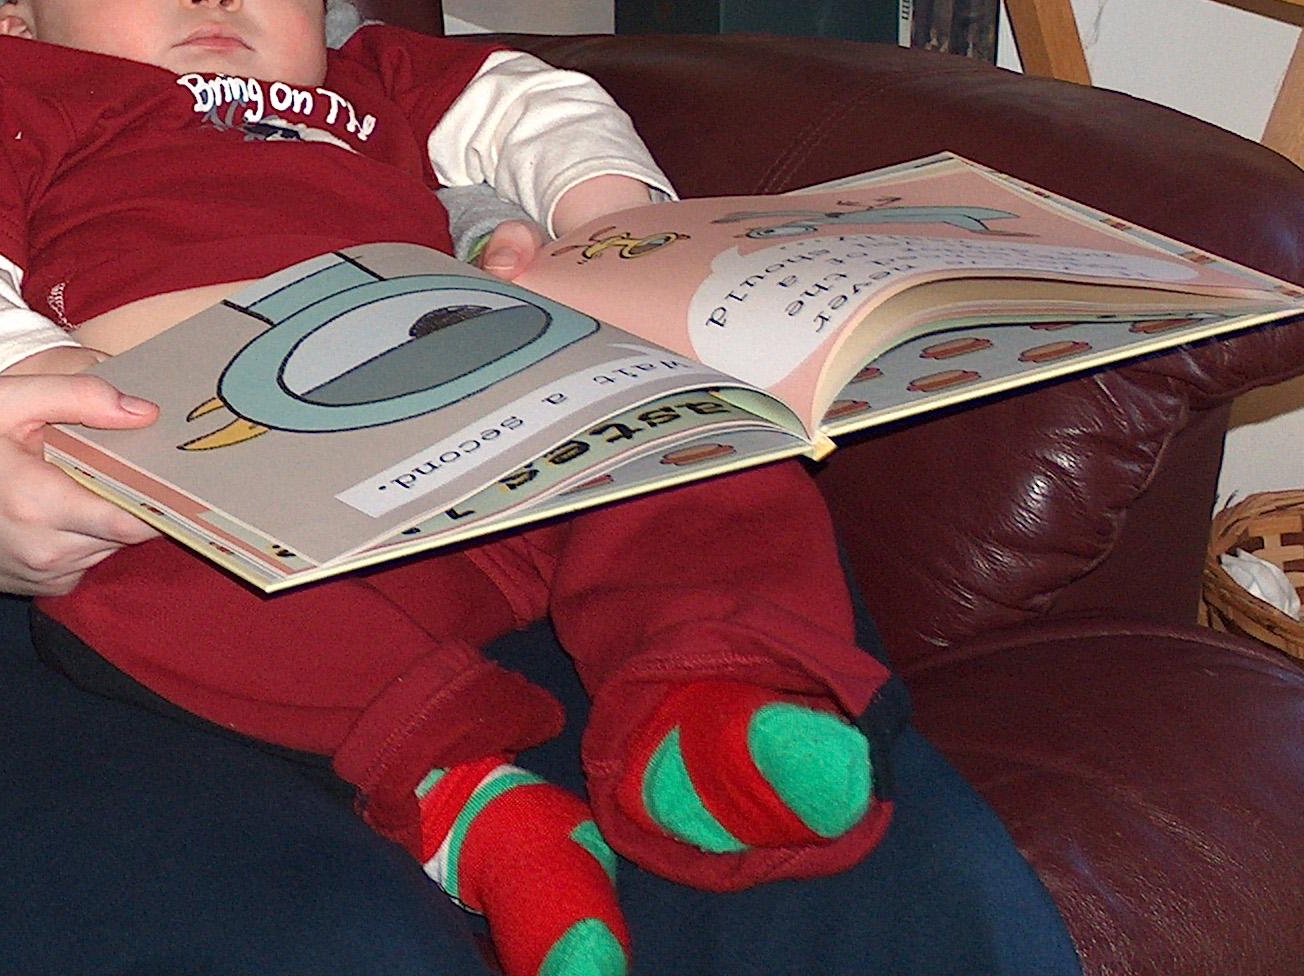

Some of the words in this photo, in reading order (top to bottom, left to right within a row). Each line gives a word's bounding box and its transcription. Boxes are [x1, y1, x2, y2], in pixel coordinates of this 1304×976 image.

[177, 73, 265, 123] Bring
[705, 248, 832, 329] should
[777, 274, 798, 289] a
[785, 271, 848, 317] the
[593, 357, 695, 387] Wait
[540, 390, 569, 407] a
[377, 415, 525, 491] second.
